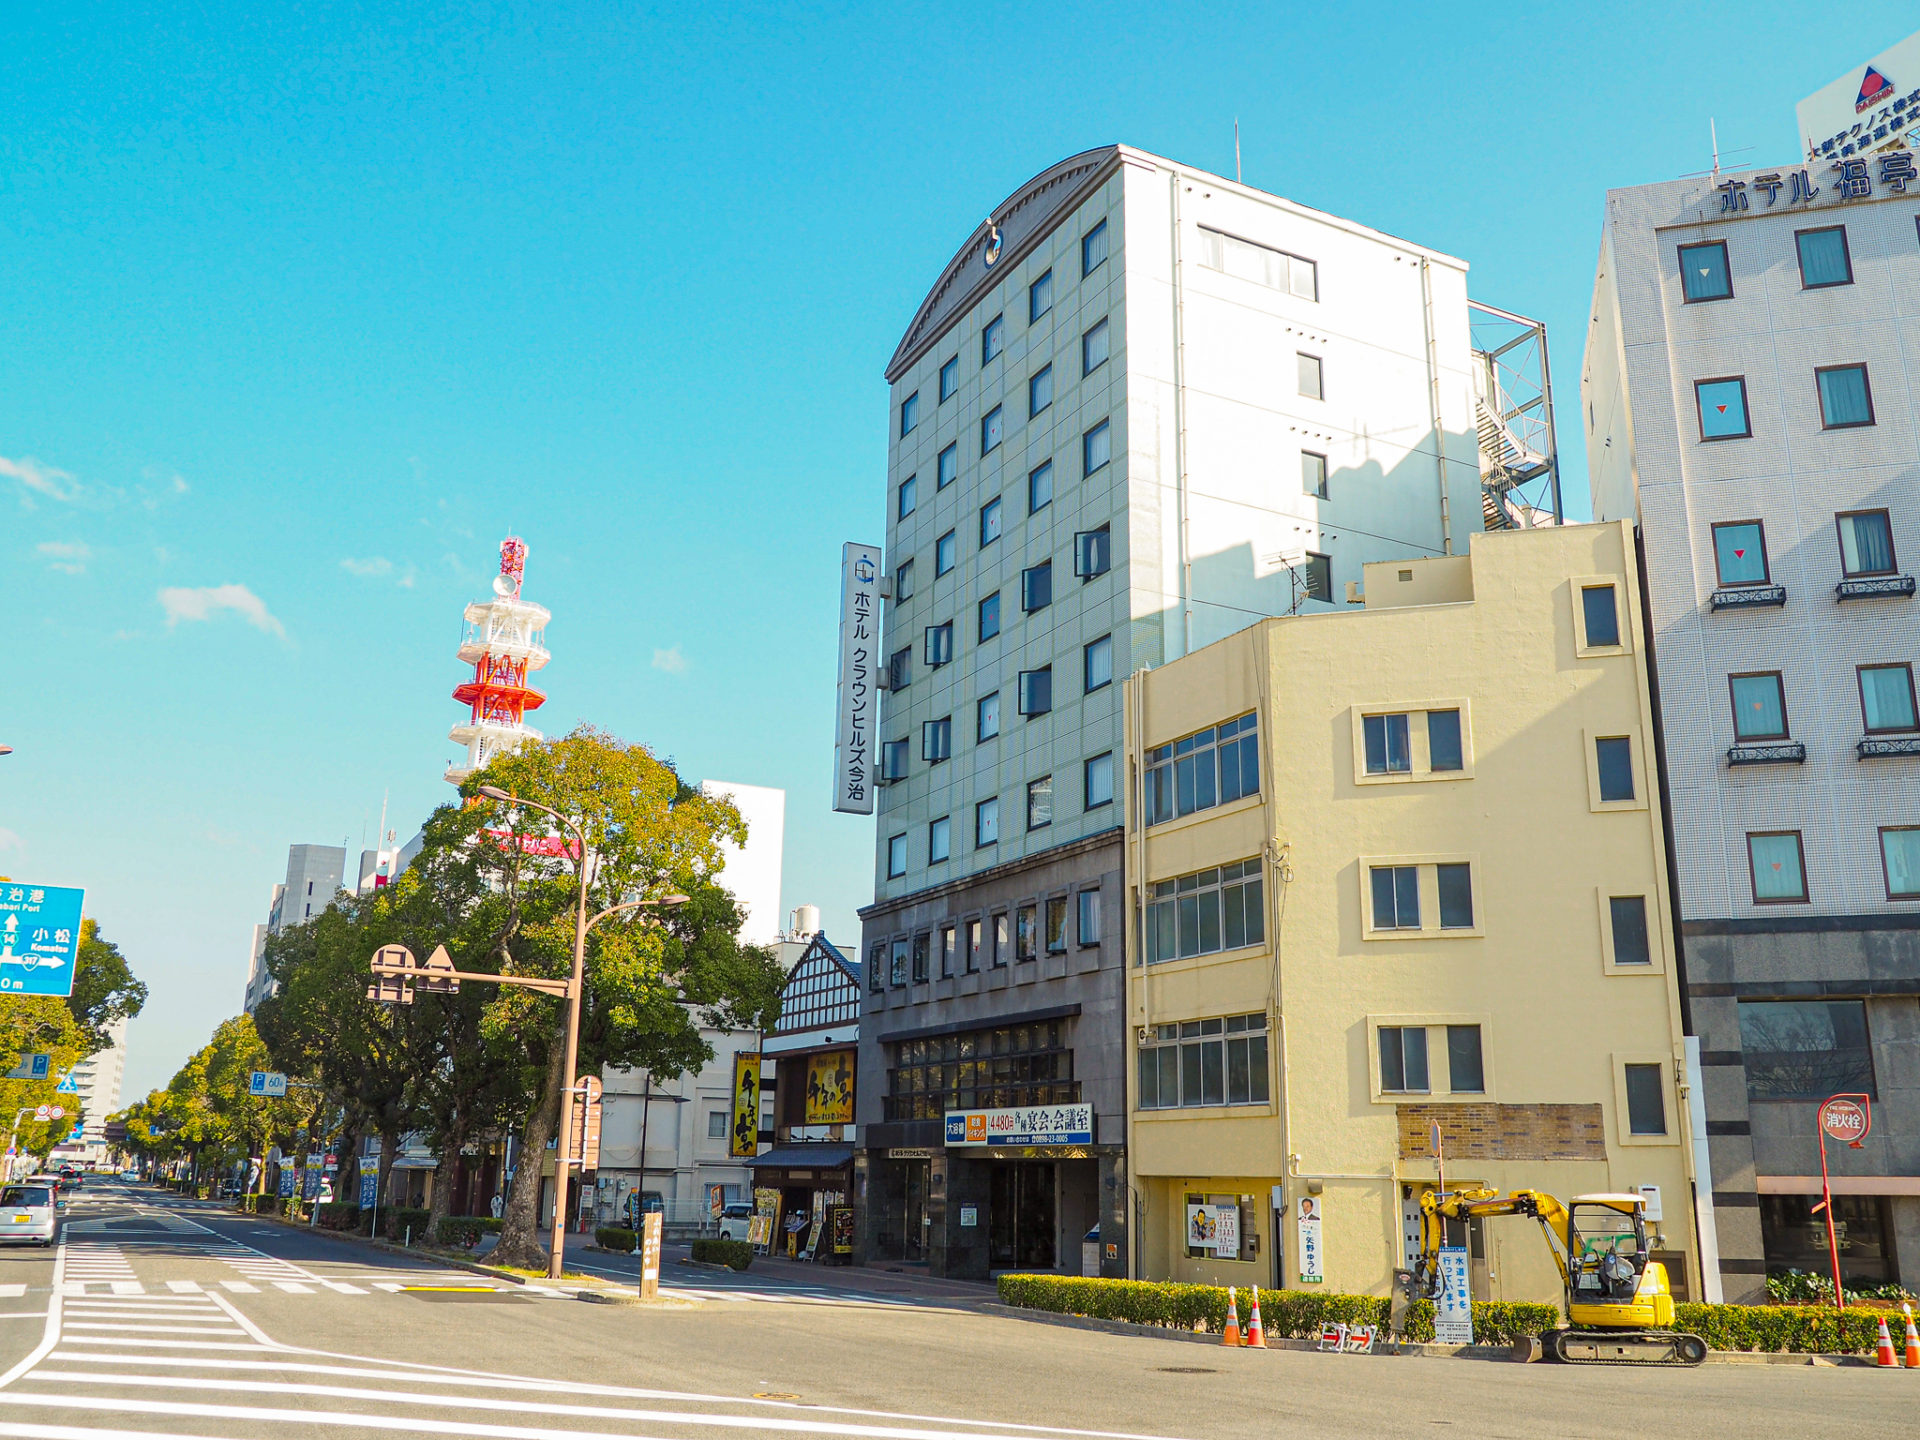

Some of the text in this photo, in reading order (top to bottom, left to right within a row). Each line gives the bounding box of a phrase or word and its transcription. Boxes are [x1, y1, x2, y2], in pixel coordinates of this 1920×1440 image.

[1856, 84, 1895, 114] DAISHIN
[0, 887, 45, 903] 治港
[22, 903, 40, 913] Port
[3, 934, 15, 944] 14
[32, 928, 71, 943] 小松
[31, 943, 69, 953] Komatsu
[23, 956, 37, 966] 317
[37, 1057, 45, 1068] P
[256, 1074, 264, 1085] P
[1826, 1112, 1861, 1129] 消火栓
[1306, 1236, 1315, 1275] 矢野ゆうし
[1442, 1256, 1455, 1312] 行っています
[1455, 1256, 1467, 1310] 水道工事を
